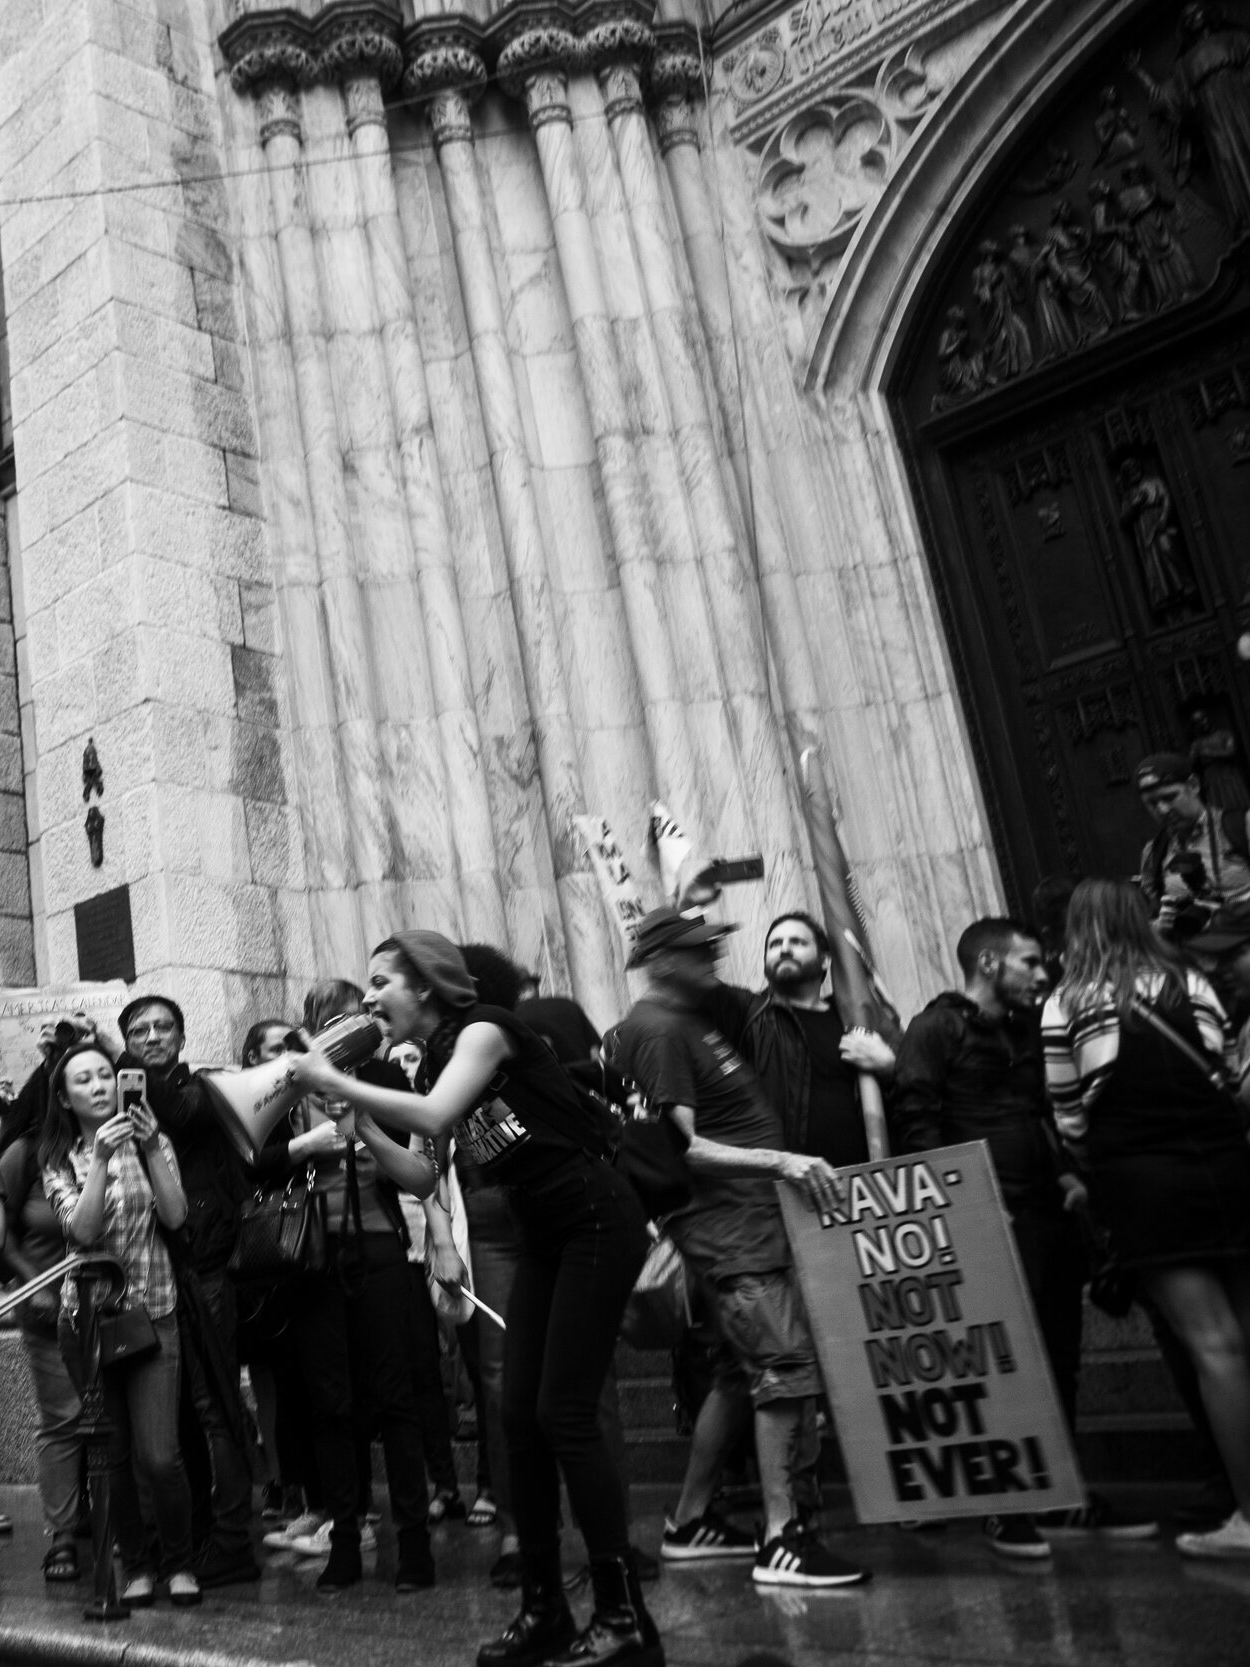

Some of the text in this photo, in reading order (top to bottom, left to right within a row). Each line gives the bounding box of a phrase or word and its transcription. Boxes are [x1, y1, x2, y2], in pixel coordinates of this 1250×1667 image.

[851, 1214, 957, 1278] NO!
[857, 1269, 964, 1333] NOT
[864, 1320, 1018, 1390] NOW!
[878, 1381, 988, 1445] NOT
[885, 1435, 1053, 1502] EVER!
